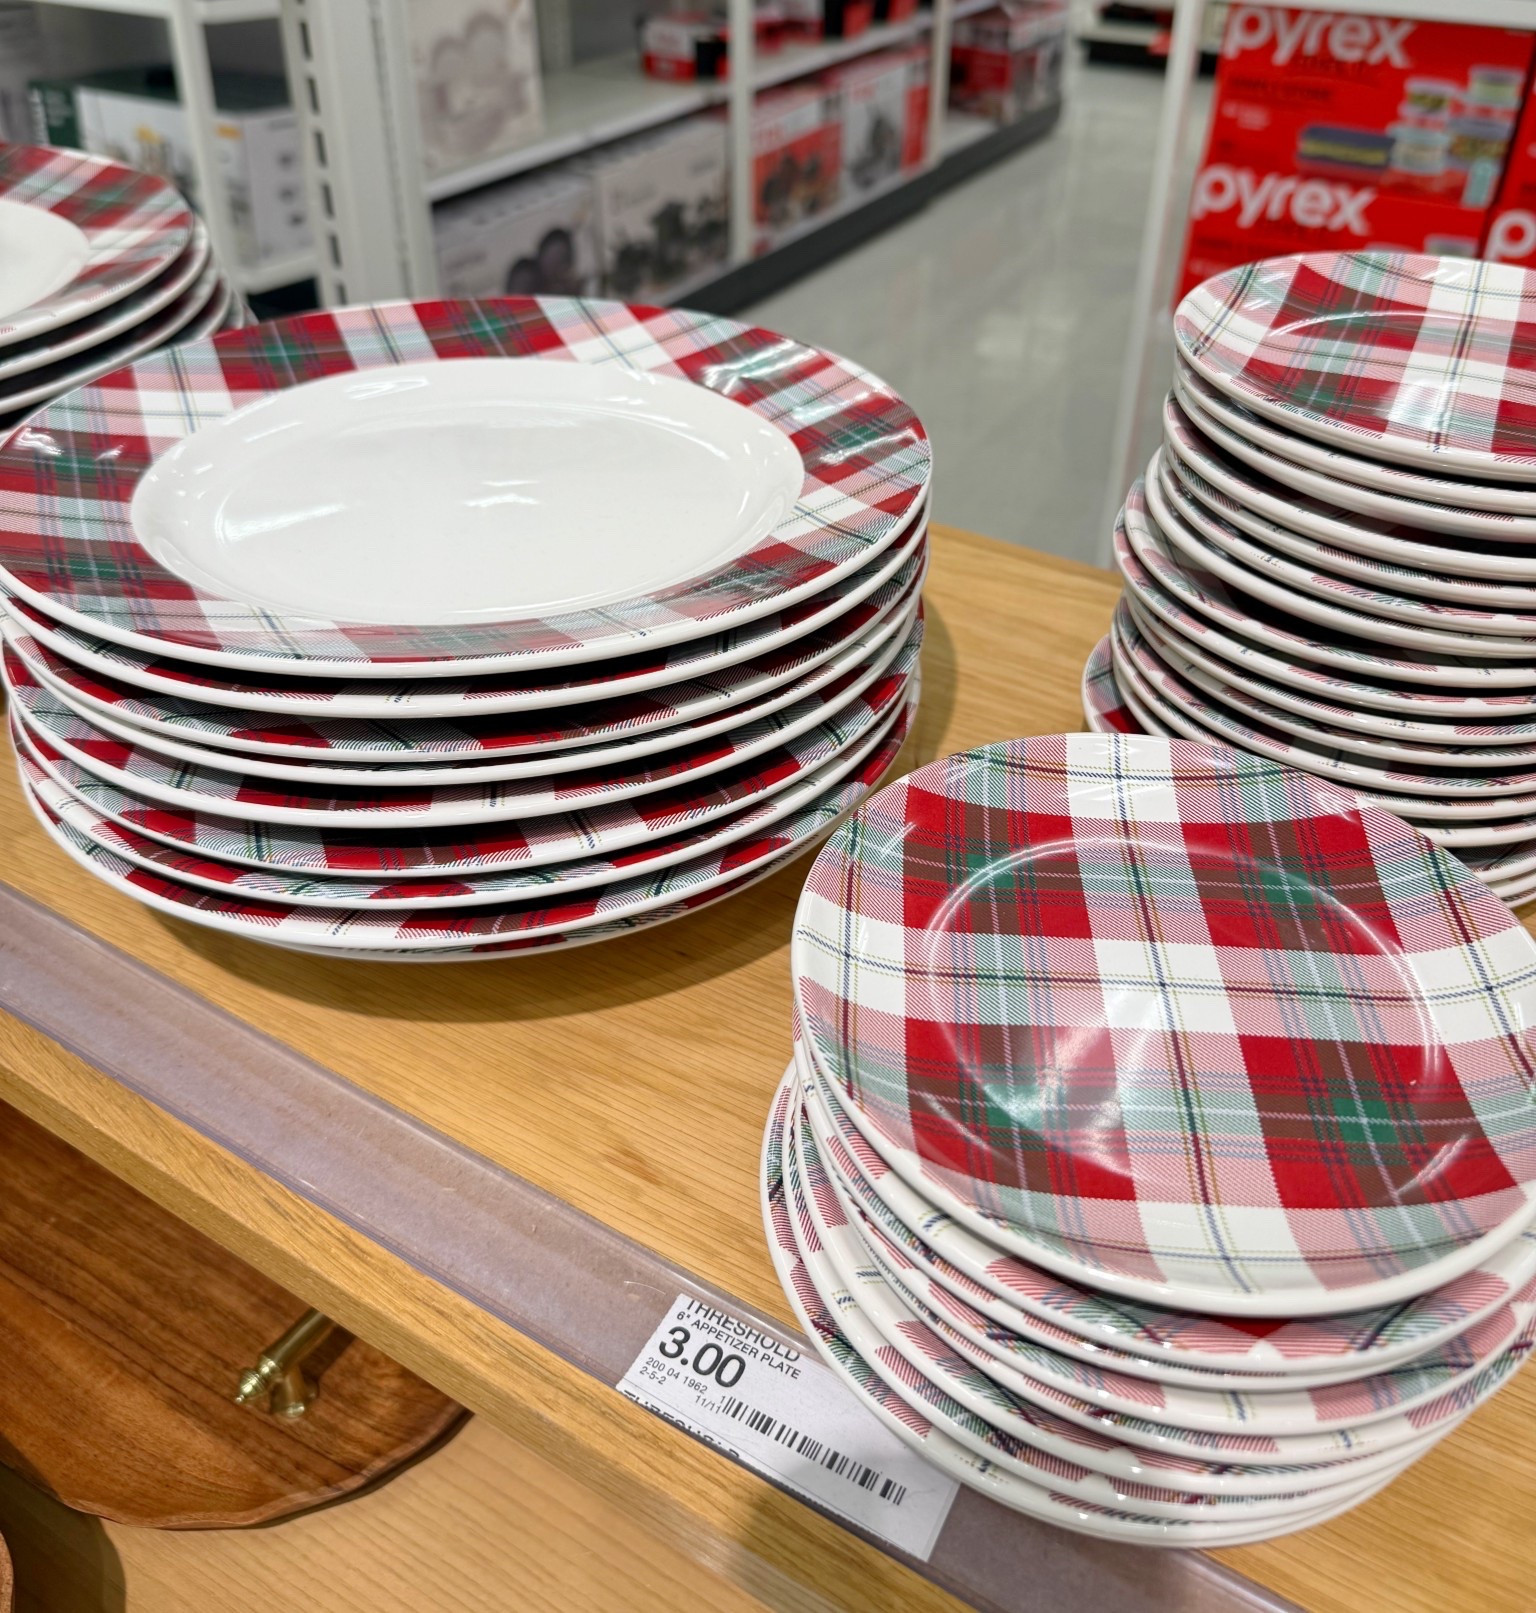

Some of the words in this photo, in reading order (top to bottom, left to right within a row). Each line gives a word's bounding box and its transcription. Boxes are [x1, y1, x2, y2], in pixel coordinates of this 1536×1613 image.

[1222, 5, 1416, 68] pyrex
[1191, 164, 1376, 236] pyrex
[640, 1366, 667, 1385] 2-5-2
[646, 1357, 666, 1372] 200
[667, 1368, 680, 1380] 04
[683, 1376, 708, 1394] 1962
[659, 1326, 746, 1388] 3.00
[691, 1319, 759, 1358] APPETIZER
[760, 1353, 801, 1380] PLATE
